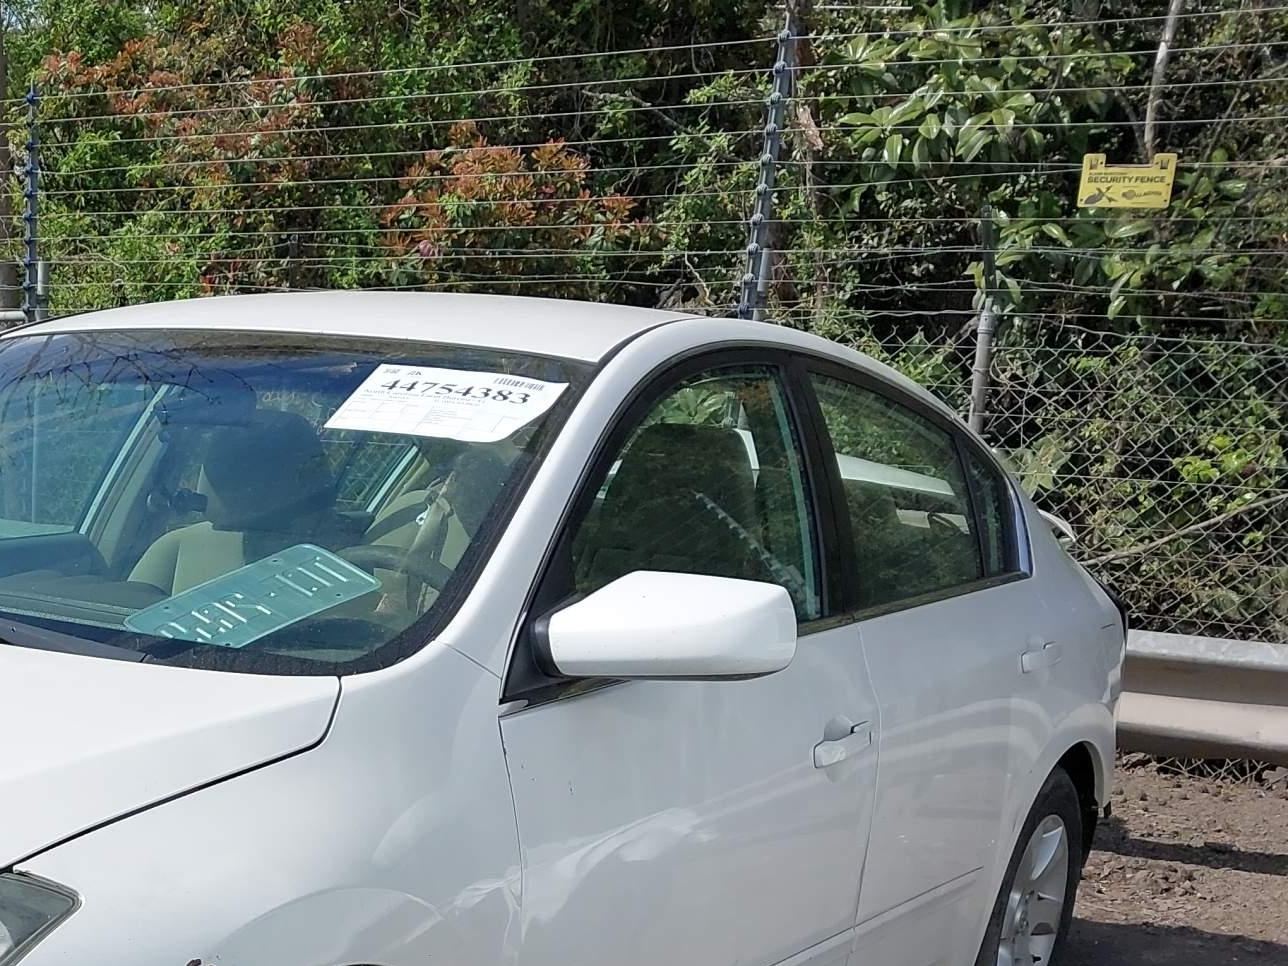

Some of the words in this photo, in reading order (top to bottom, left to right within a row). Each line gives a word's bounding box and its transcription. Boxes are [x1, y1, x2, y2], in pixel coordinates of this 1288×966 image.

[1087, 175, 1134, 184] SECURITY
[1134, 175, 1166, 184] FENCE
[380, 378, 531, 405] 44754383
